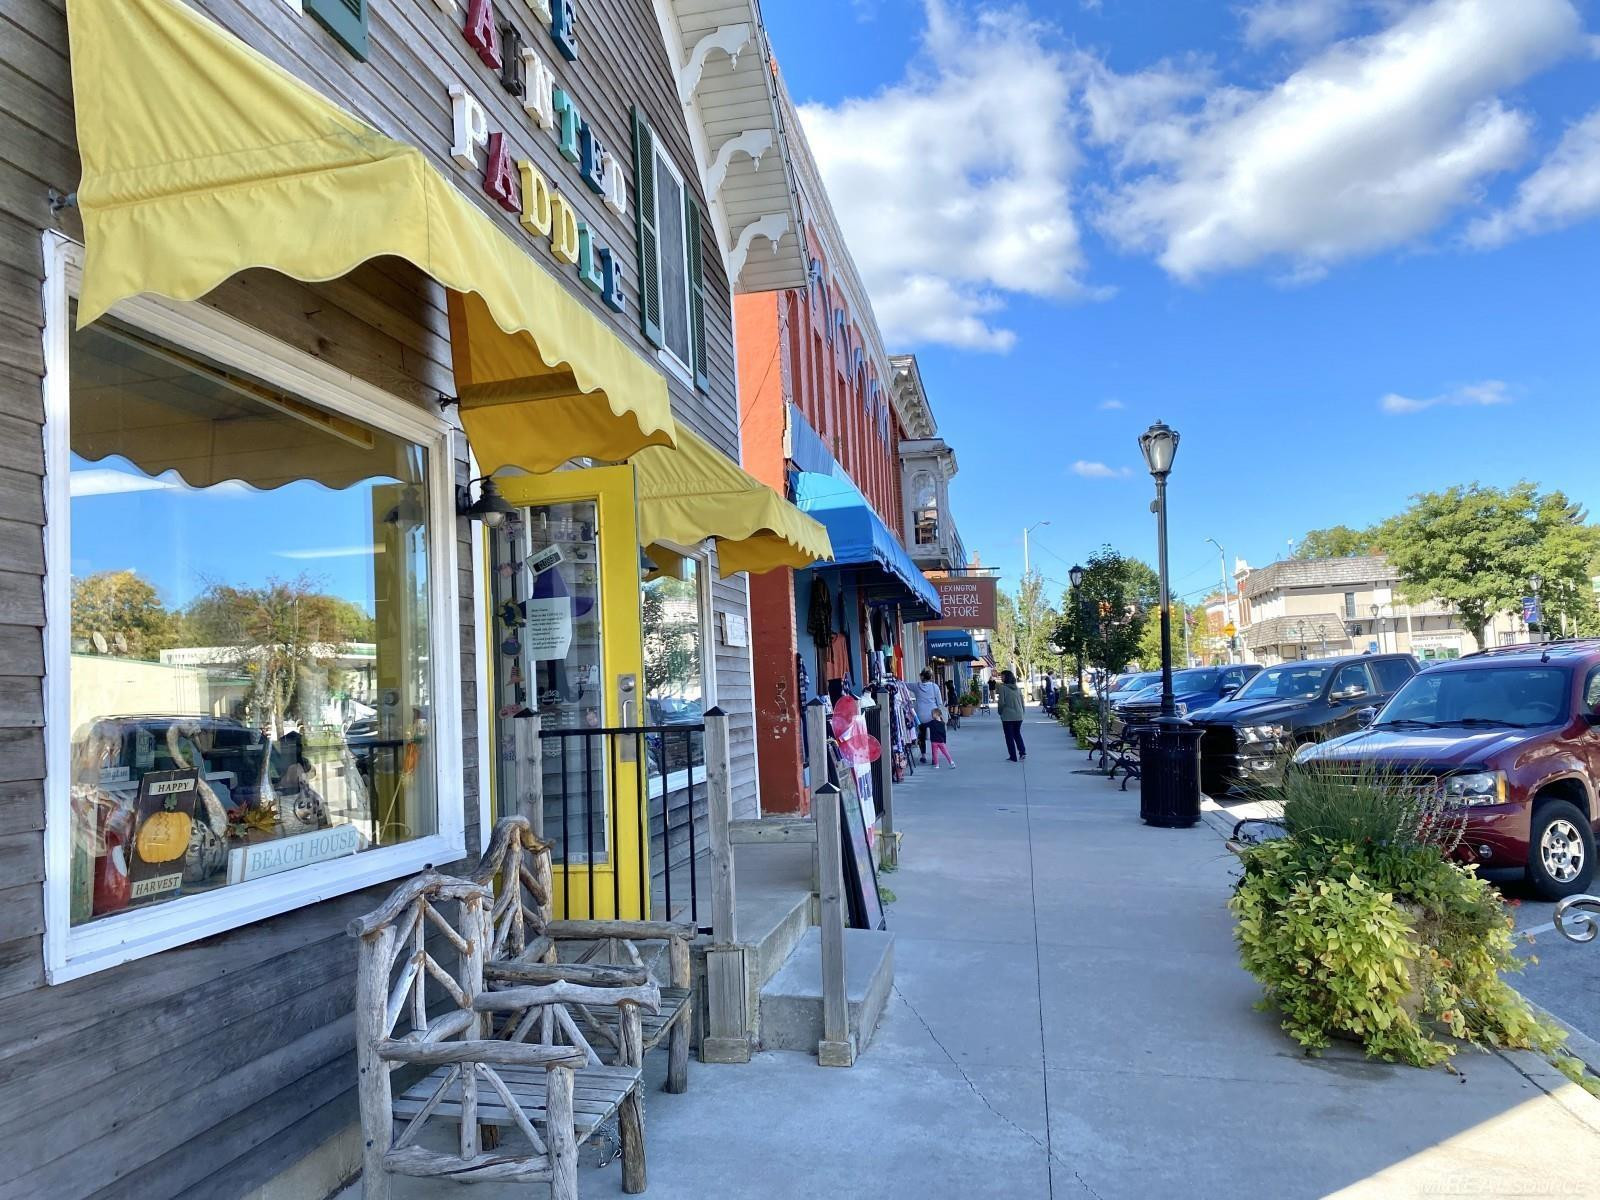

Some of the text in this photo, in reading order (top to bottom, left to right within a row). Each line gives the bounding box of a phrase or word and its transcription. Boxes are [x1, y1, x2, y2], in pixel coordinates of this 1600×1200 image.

[435, 0, 627, 215] AINTED
[448, 83, 626, 313] PADDLE
[940, 584, 977, 592] LEXINGTON
[940, 594, 982, 605] ENERAL
[943, 606, 980, 617] STORE
[157, 781, 190, 793] HAPPY
[251, 830, 357, 872] BEACH HOUSE
[135, 876, 180, 896] HARVEST
